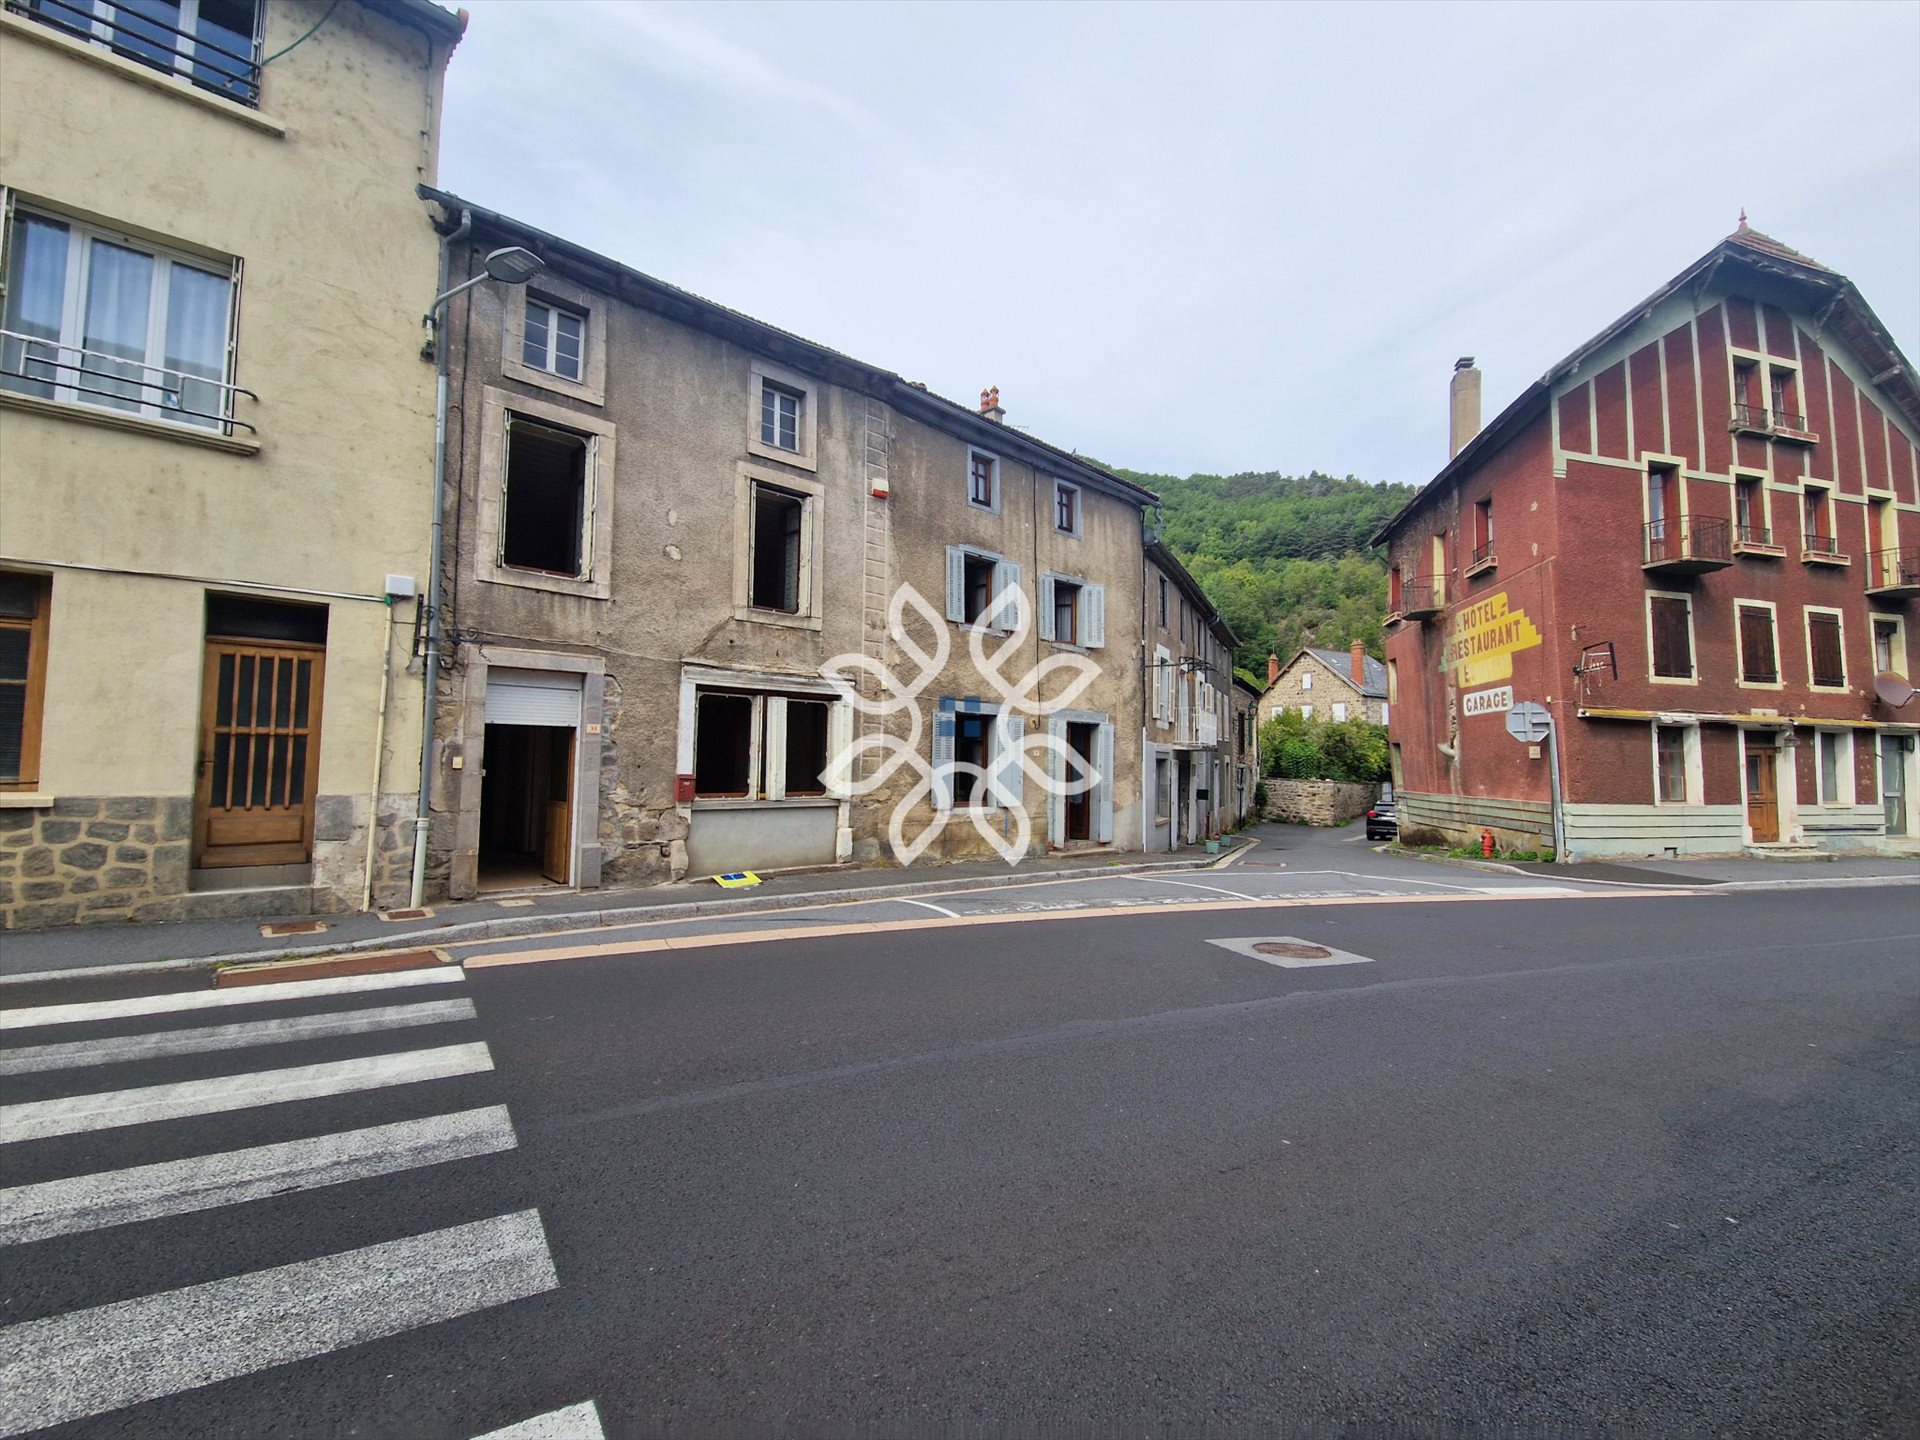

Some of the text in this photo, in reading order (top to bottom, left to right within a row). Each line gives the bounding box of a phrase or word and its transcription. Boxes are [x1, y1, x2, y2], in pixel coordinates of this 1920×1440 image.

[1463, 601, 1497, 630] HOTEL
[1448, 620, 1521, 662] RESTAURANT
[1466, 691, 1508, 713] GARAGE
